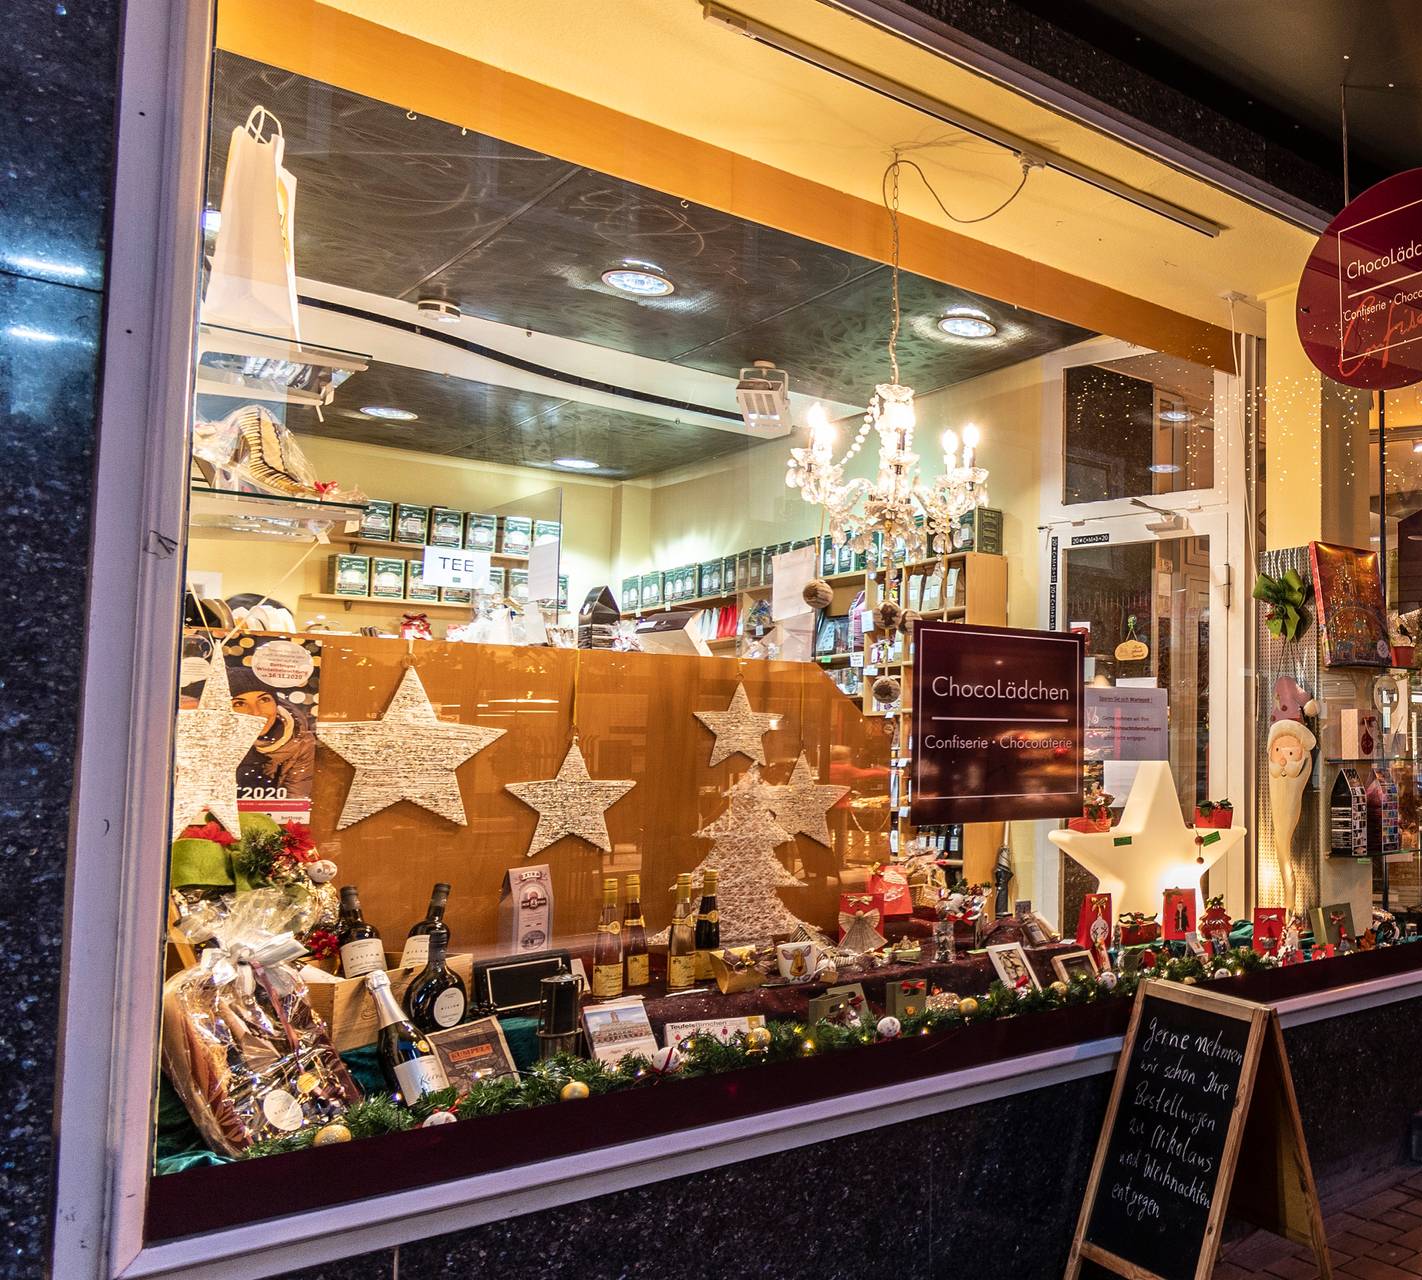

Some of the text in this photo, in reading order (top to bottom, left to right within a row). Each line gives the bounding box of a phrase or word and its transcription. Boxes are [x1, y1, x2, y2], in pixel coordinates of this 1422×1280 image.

[1343, 300, 1387, 322] Confiserie
[438, 556, 475, 573] TEE
[931, 675, 1070, 701] ChocoLädchen
[924, 734, 1073, 749] Confiserie Chocolaterie
[1140, 1056, 1159, 1074] wir
[1163, 1055, 1196, 1085] schon
[1134, 1080, 1216, 1135] Bestellungen
[1150, 1124, 1214, 1173] Nikolaus
[1119, 1150, 1211, 1209] und Weihnachten
[1111, 1177, 1160, 1221] entgegen
